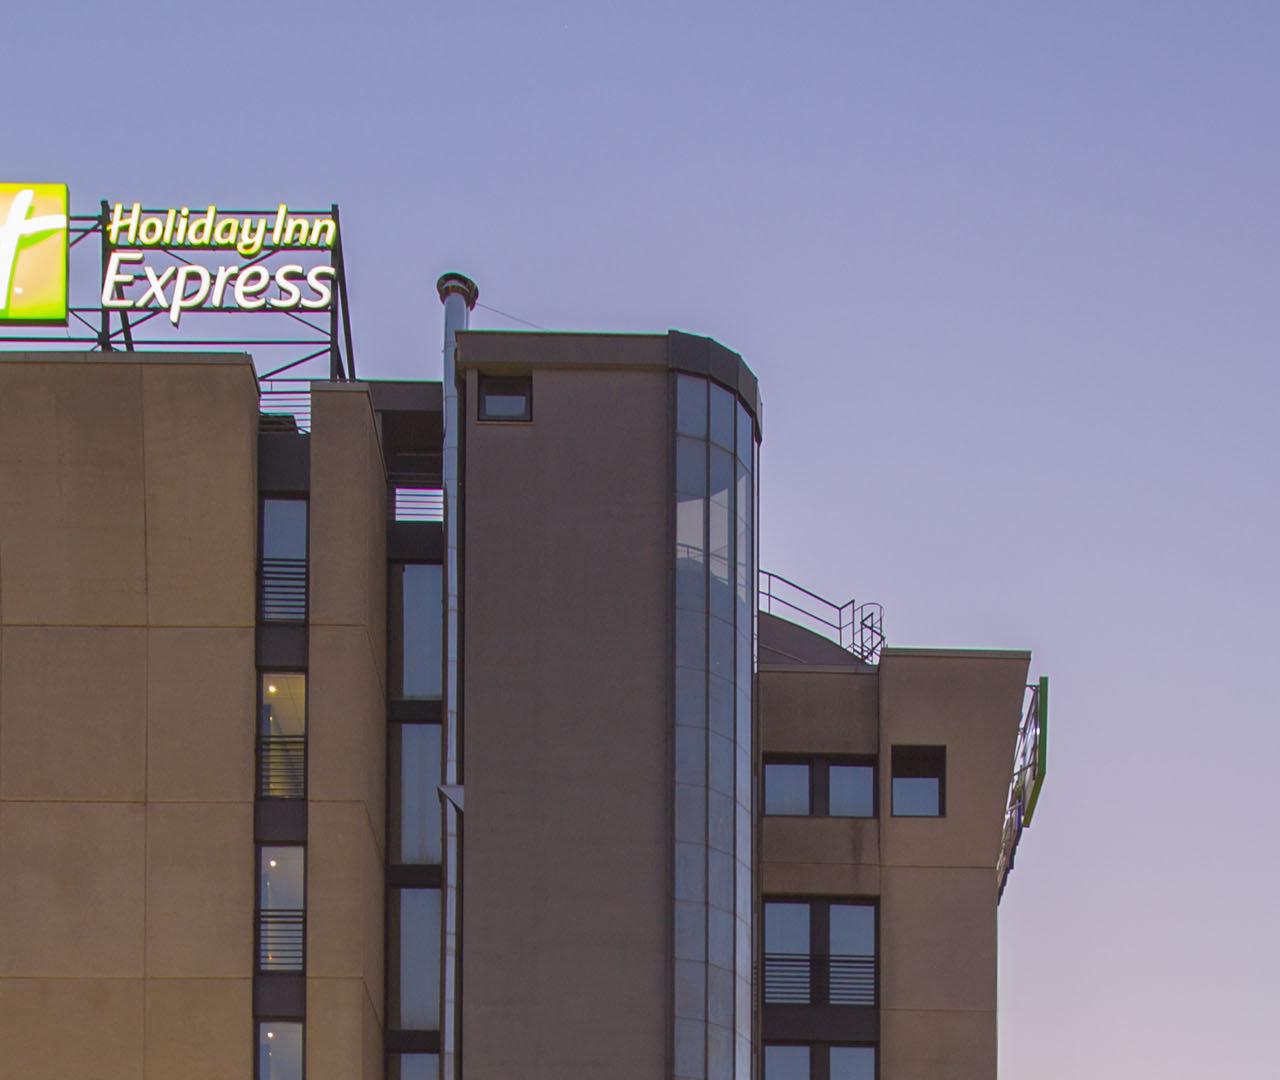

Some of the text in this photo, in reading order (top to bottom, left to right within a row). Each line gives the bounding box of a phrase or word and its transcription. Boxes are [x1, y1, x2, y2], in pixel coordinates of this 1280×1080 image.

[107, 202, 337, 257] Holiday Inn
[101, 251, 337, 327] Express
